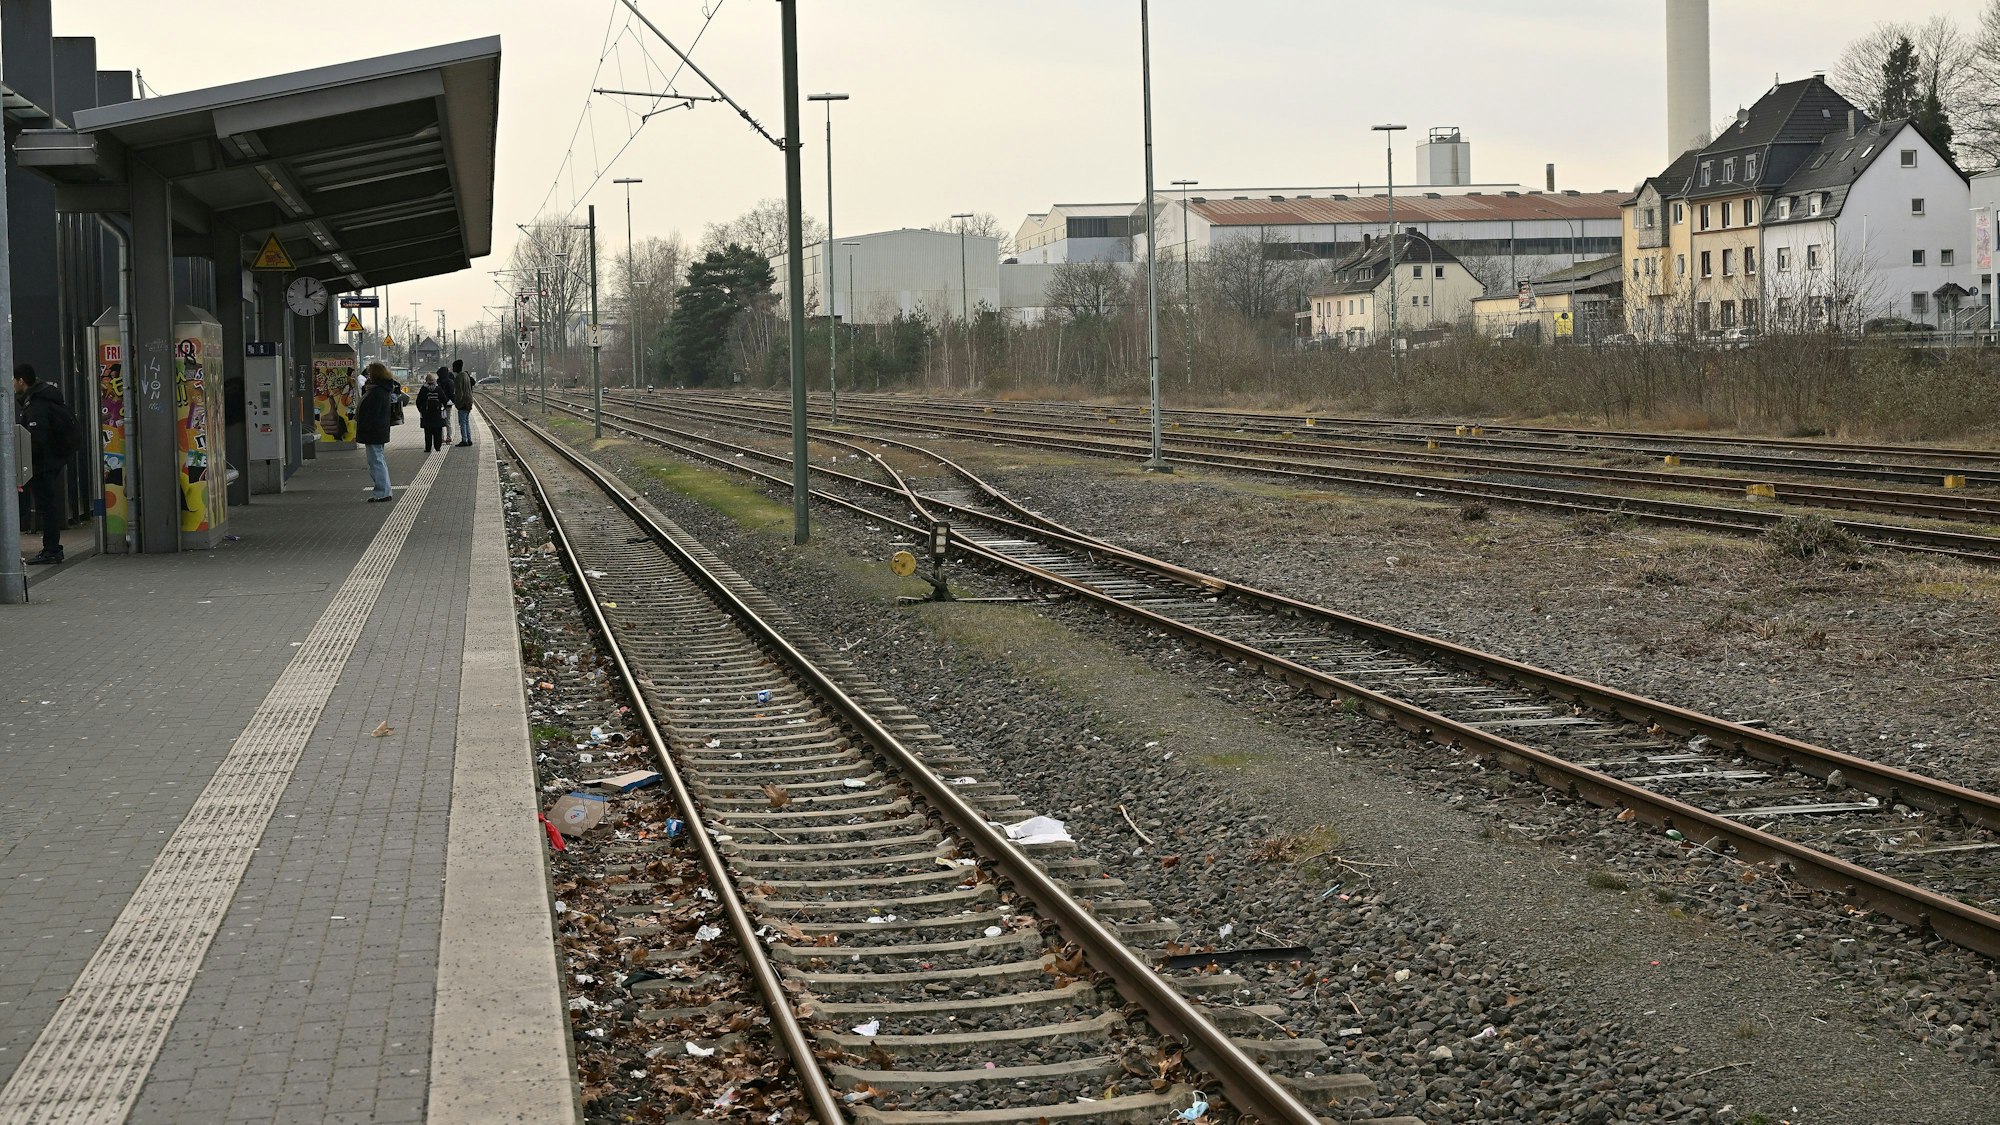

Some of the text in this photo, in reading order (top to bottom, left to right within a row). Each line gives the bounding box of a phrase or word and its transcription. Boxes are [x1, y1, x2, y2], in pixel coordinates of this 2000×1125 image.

[591, 325, 598, 335] 9
[592, 335, 598, 344] 4
[106, 346, 121, 360] FRI
[150, 356, 161, 400] LION
